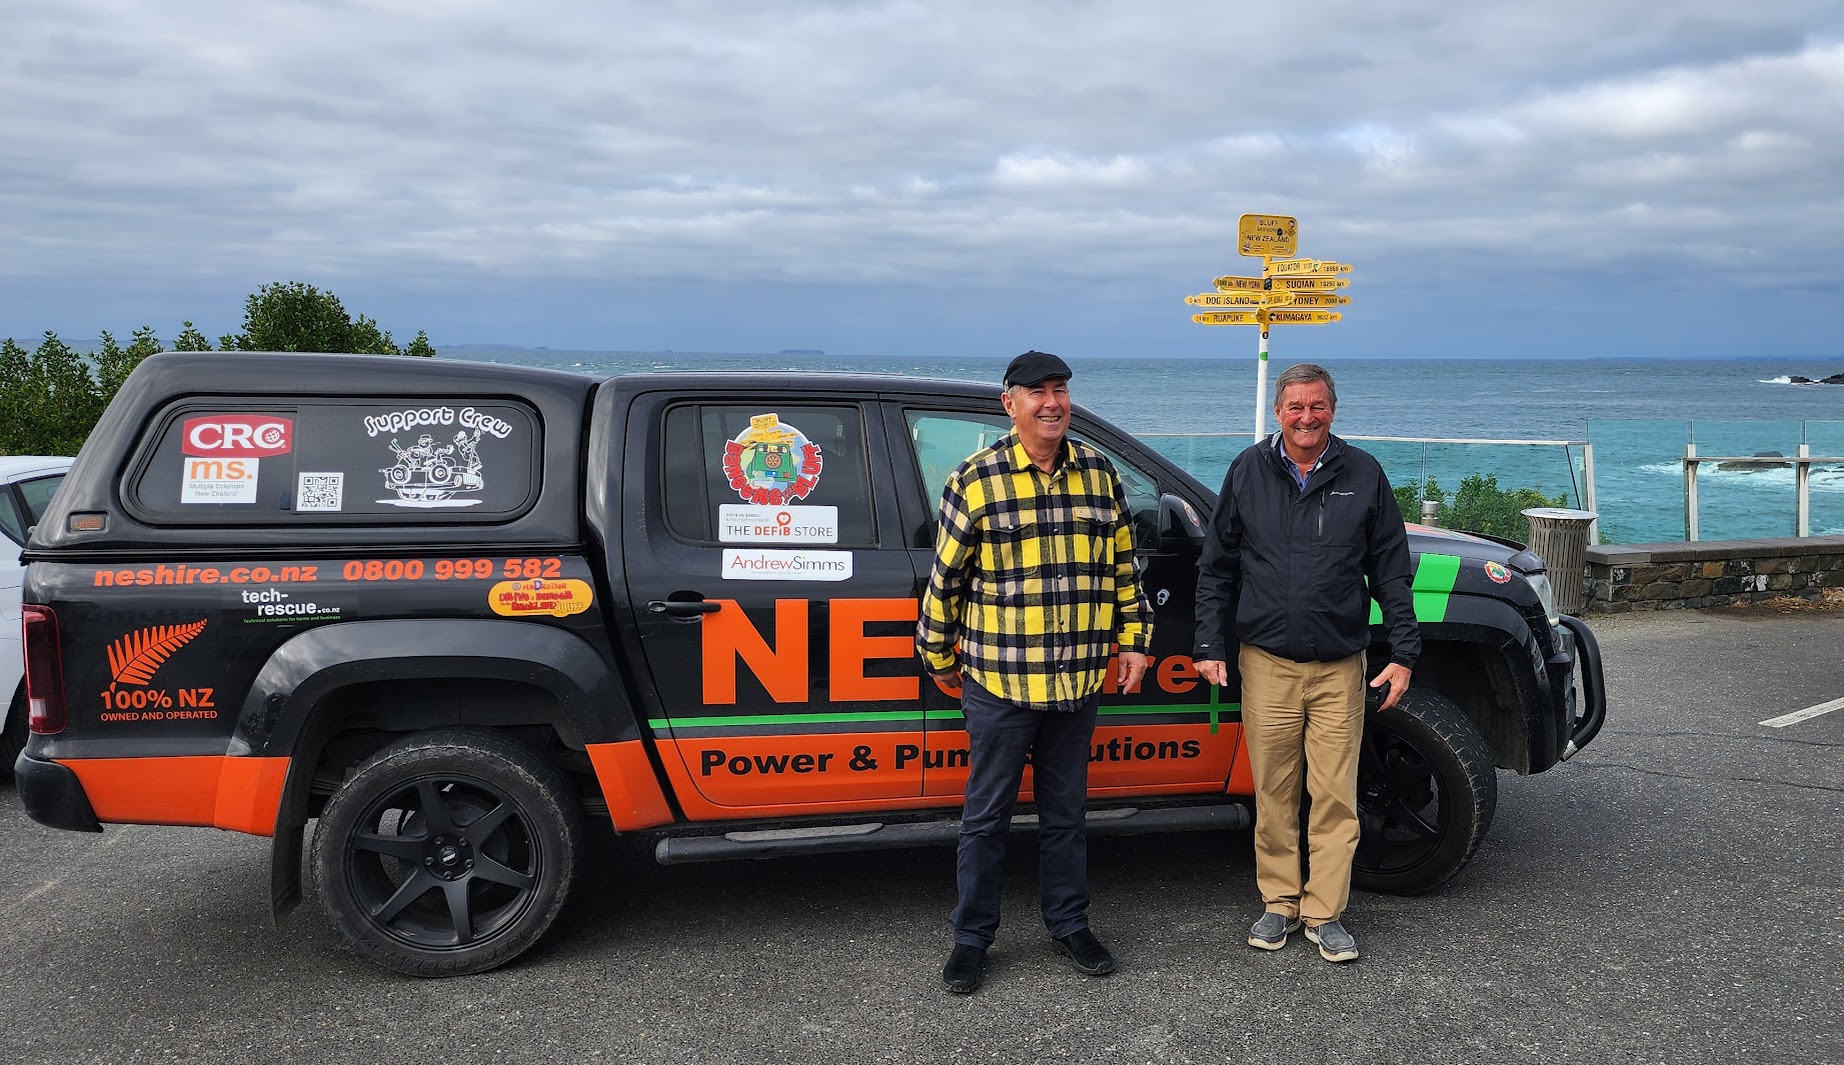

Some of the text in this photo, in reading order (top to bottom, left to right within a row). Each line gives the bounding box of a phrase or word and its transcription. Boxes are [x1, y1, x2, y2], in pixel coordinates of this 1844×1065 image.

[1262, 235, 1290, 243] ZEALAND
[1277, 263, 1300, 273] EQUATOR
[1236, 280, 1247, 288] NEW
[1248, 280, 1261, 288] YORK
[1286, 280, 1315, 288] SUQIAN
[1206, 297, 1221, 305] DOG
[1223, 297, 1250, 305] ISLAND
[1213, 314, 1244, 323] RUAPUKE
[1276, 313, 1312, 321] KUMAGAYA
[364, 406, 513, 438] Support Crew
[190, 423, 285, 449] CRC
[190, 460, 253, 480] ms.
[794, 442, 821, 499] BLUFF
[726, 525, 750, 536] THE
[794, 526, 833, 537] STORE
[731, 555, 845, 571] AndrewSimms
[94, 558, 562, 586] neshire.co.nz 0800 999 582
[242, 588, 288, 603] tech-
[257, 603, 341, 616] rescue.co.nz
[101, 688, 215, 710] 100% NZ
[101, 710, 218, 721] OWNED AND OPERATED
[701, 749, 834, 776] Power
[848, 745, 878, 772] &
[895, 744, 971, 769] Pum
